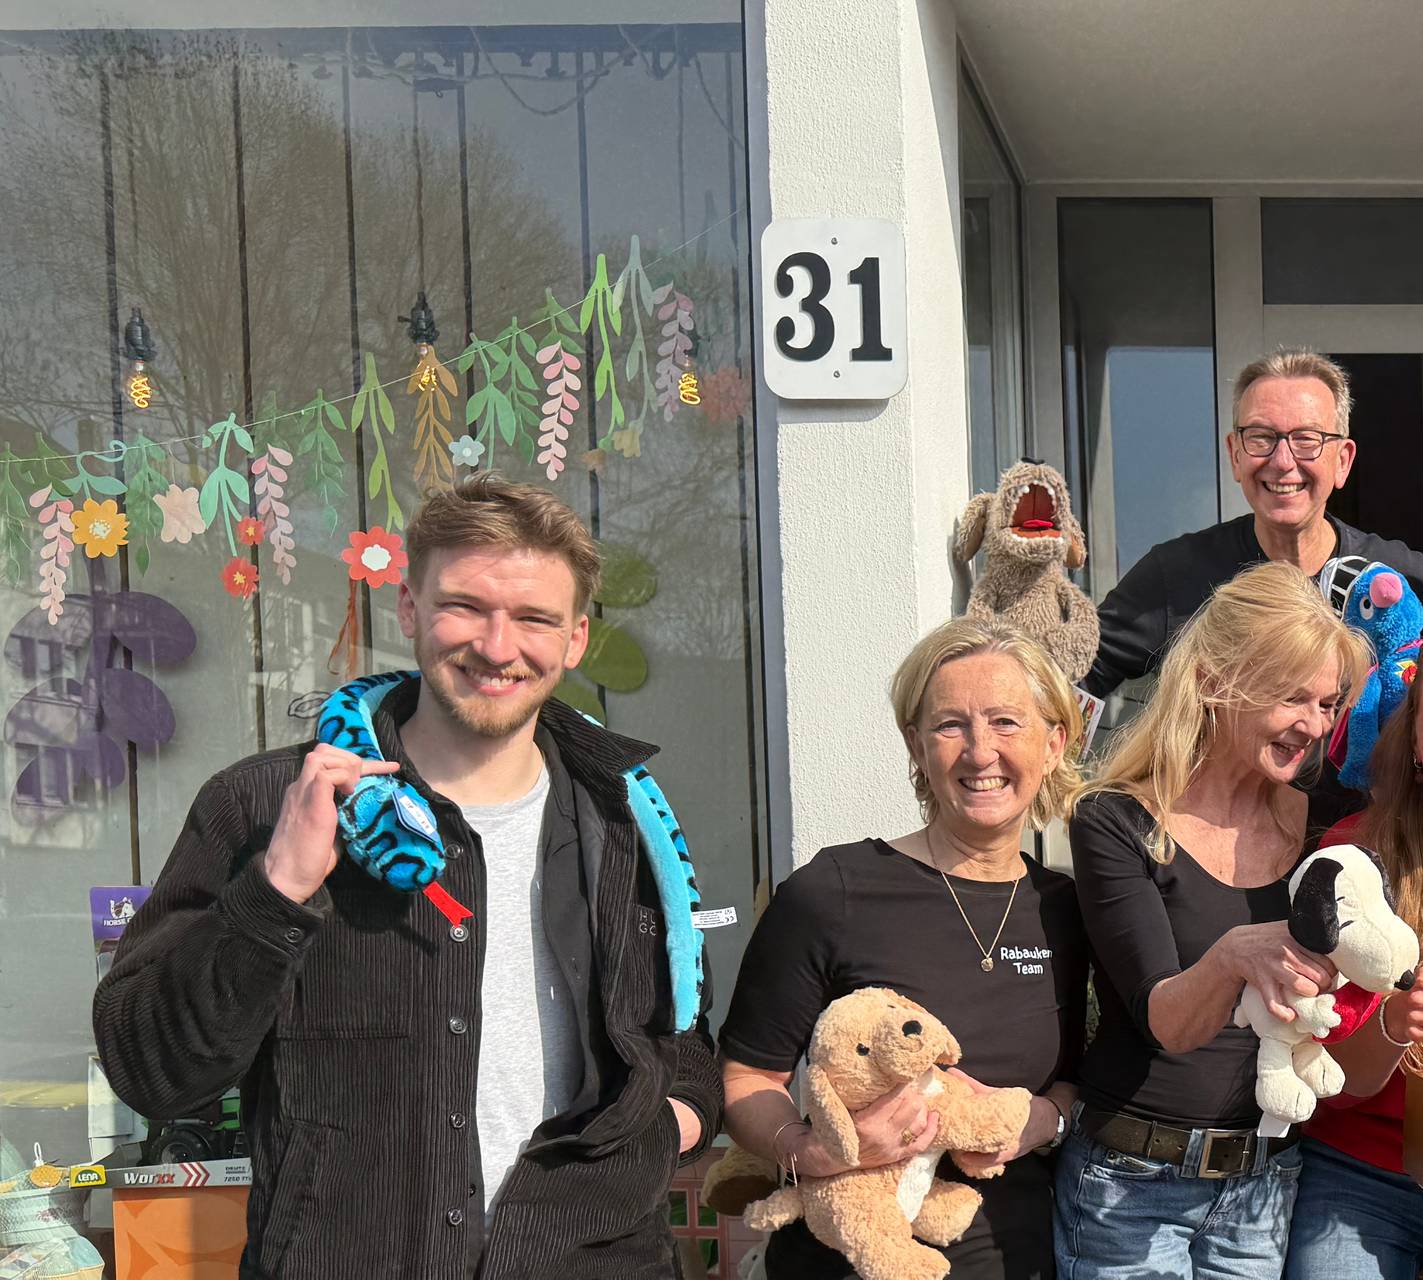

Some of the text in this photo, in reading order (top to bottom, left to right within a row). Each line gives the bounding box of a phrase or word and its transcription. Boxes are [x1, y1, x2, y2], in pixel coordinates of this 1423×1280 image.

[774, 251, 893, 362] 31
[1000, 946, 1053, 961] Rabauken
[1012, 962, 1044, 975] Team
[124, 1172, 176, 1185] Worxx
